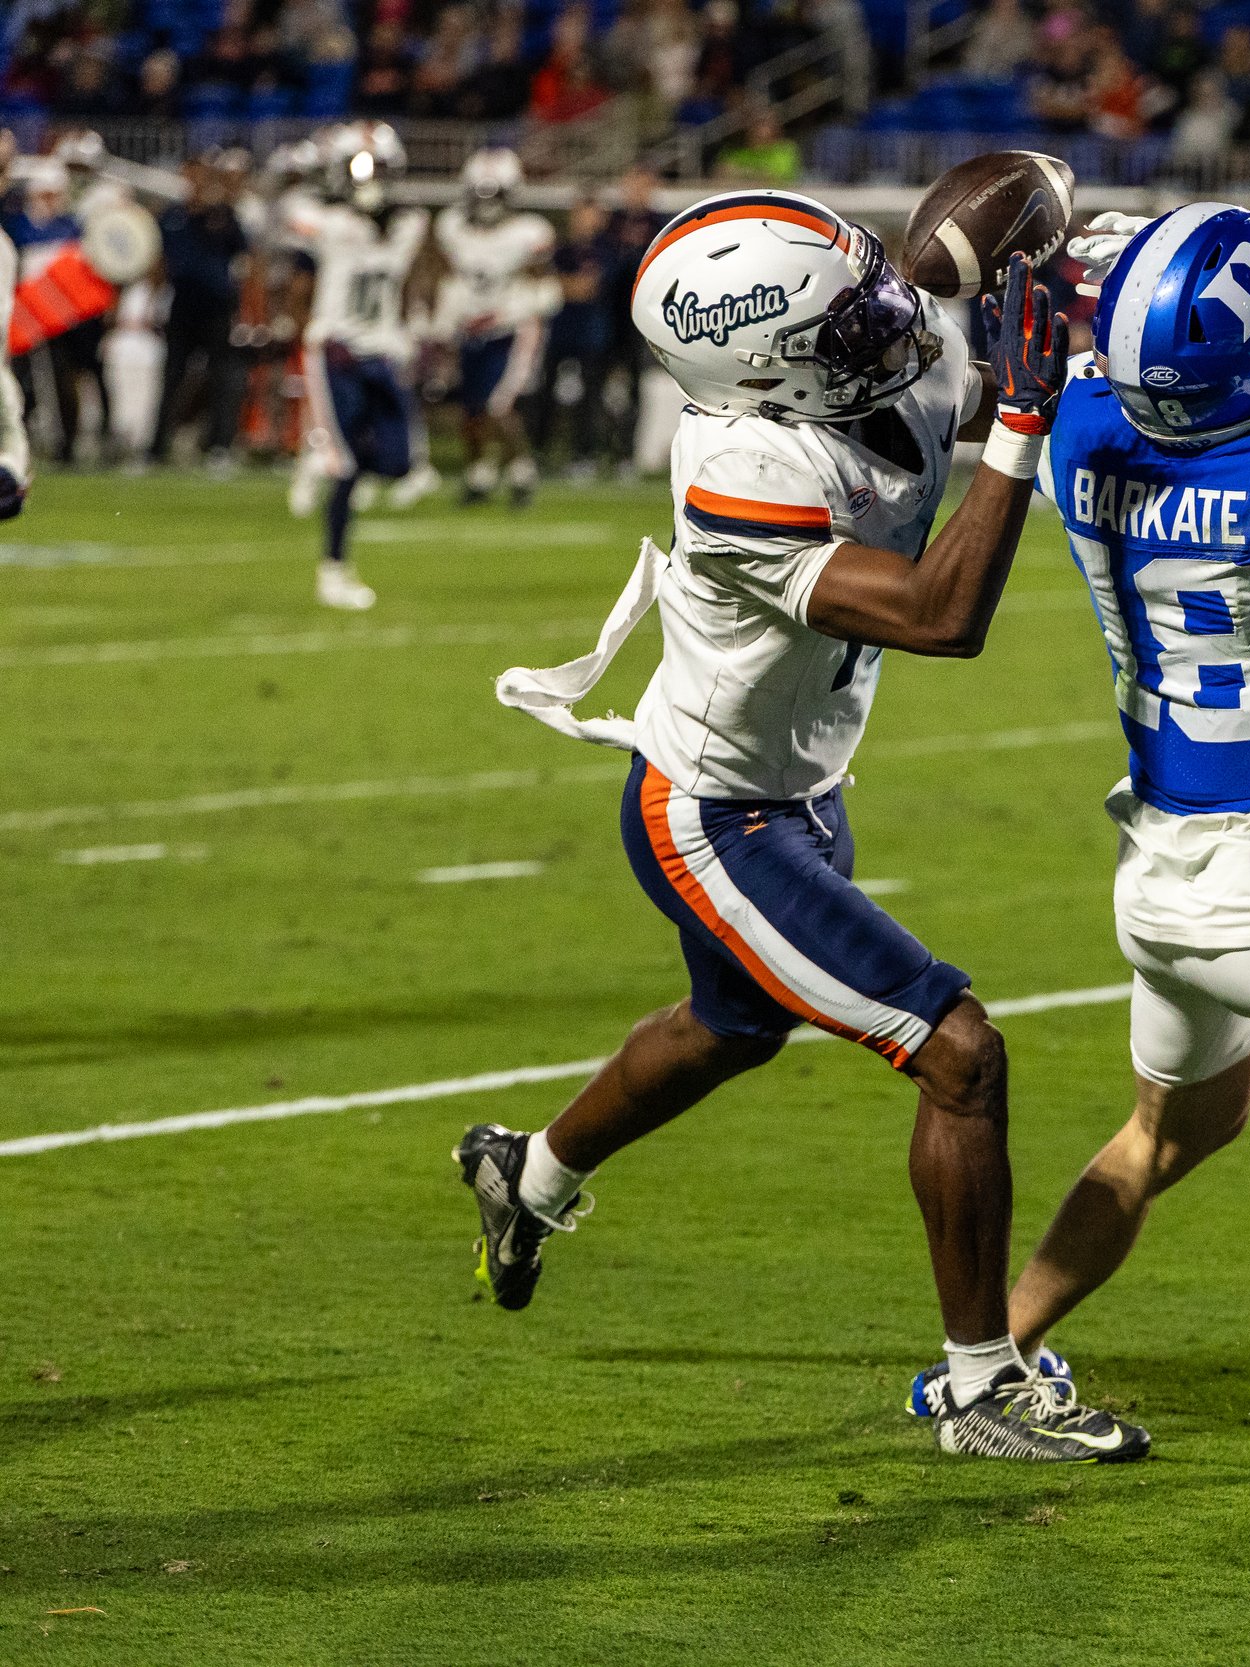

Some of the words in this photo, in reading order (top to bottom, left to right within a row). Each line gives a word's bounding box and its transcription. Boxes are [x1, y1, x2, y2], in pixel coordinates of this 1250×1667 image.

[665, 286, 788, 345] Virginia
[1147, 370, 1175, 380] ACC
[850, 490, 871, 511] ACC
[1073, 468, 1247, 545] BARKATE
